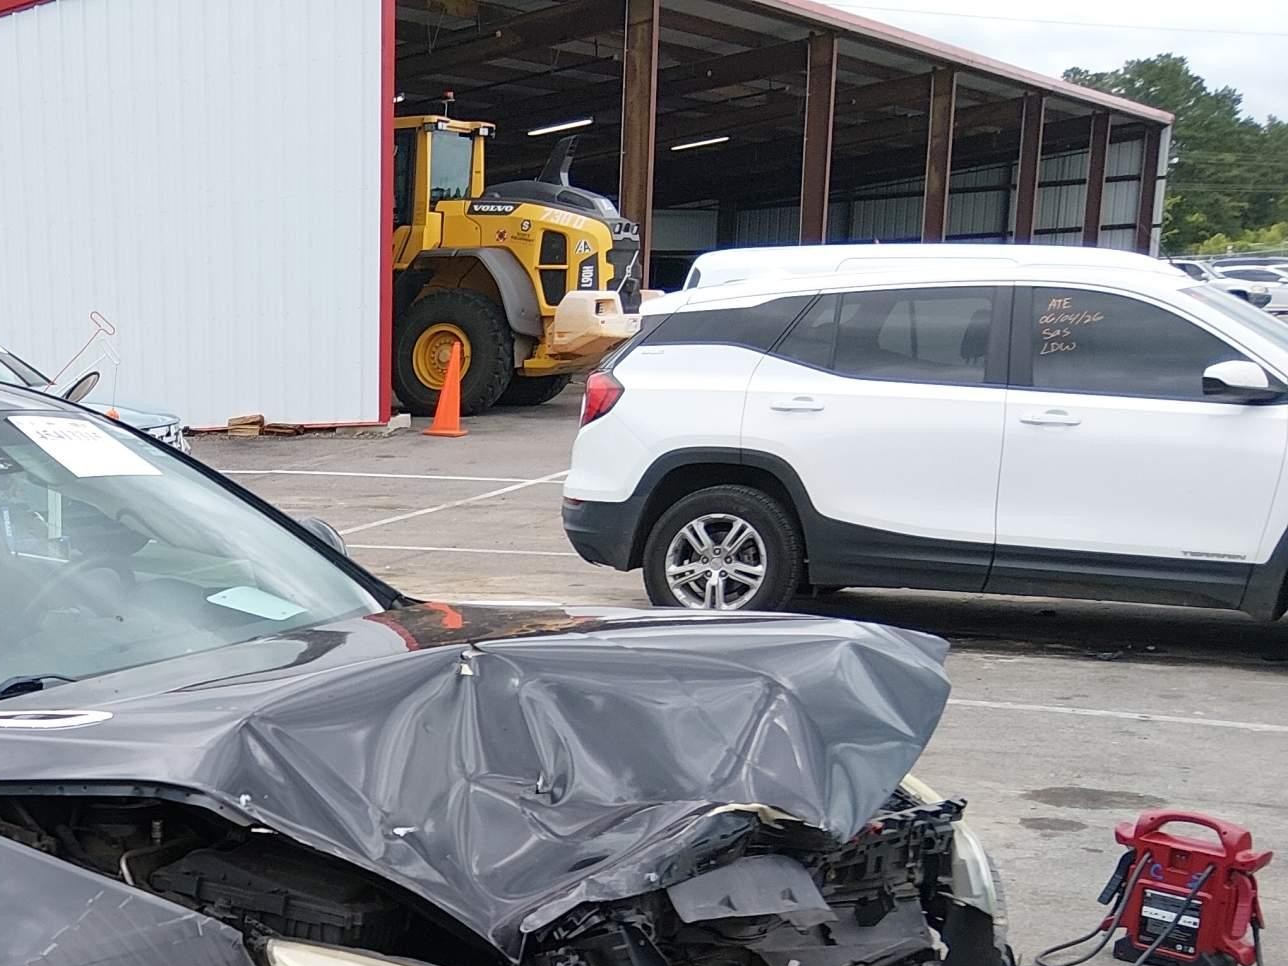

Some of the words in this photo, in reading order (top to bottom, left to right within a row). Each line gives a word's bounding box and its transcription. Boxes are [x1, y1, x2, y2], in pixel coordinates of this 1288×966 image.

[473, 204, 514, 212] VOLVO
[581, 266, 594, 287] L90H
[1048, 298, 1072, 310] ATE
